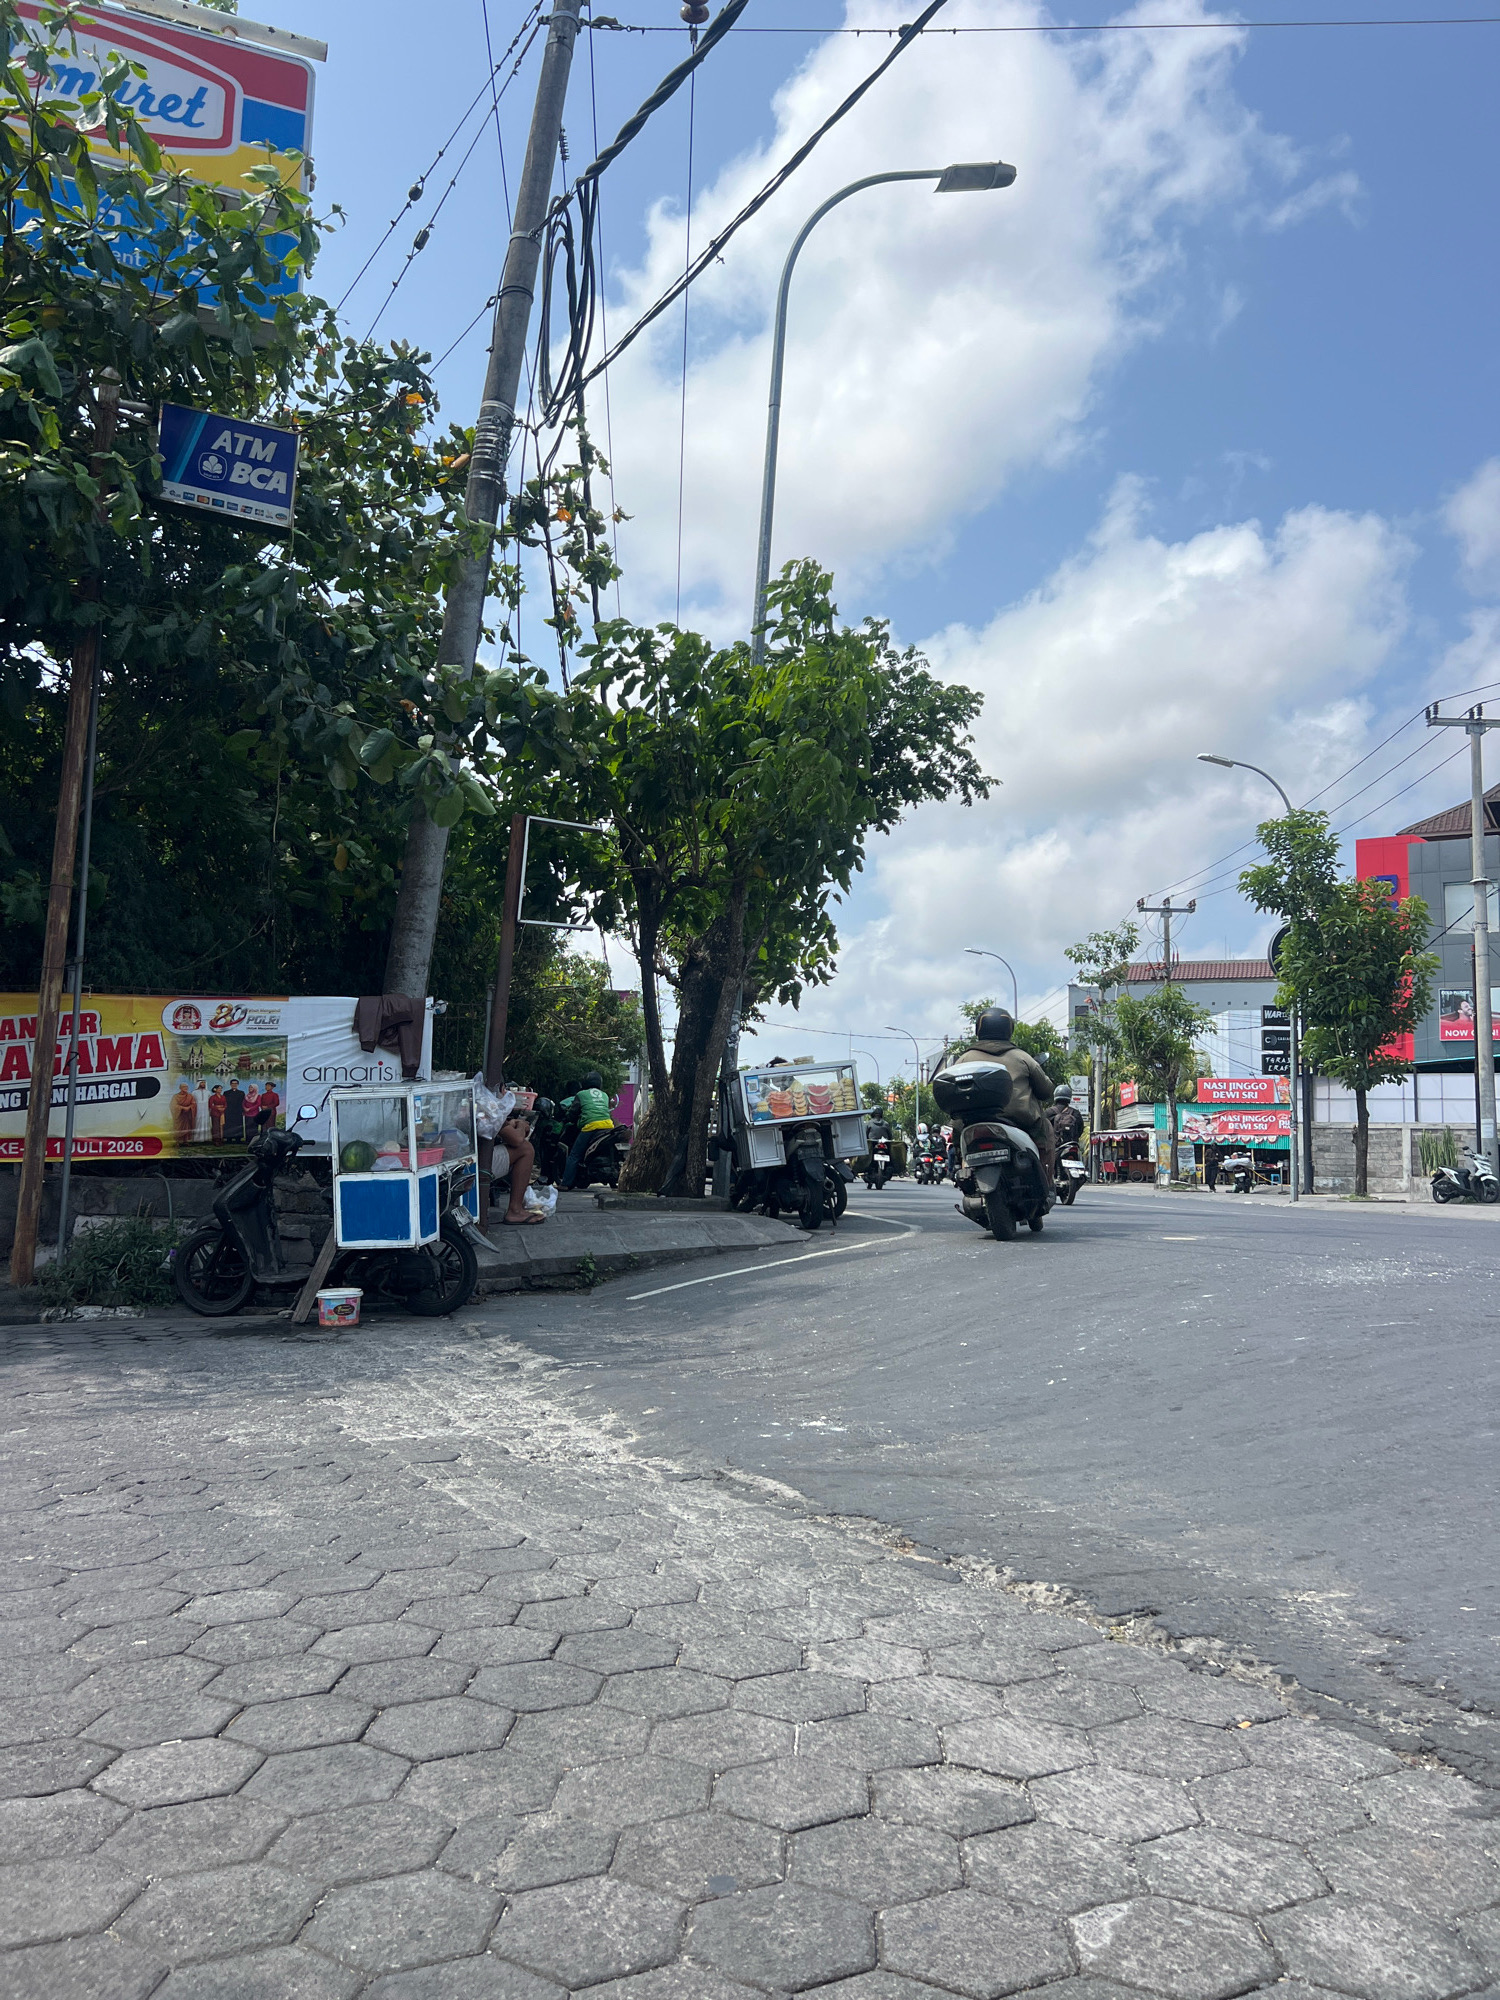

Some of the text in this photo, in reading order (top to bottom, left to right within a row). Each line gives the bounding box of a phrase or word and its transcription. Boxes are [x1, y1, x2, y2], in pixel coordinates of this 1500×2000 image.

[211, 430, 278, 463] ATM
[229, 461, 288, 494] BCA
[246, 1015, 280, 1025] POLRI
[302, 1061, 394, 1082] amaris
[1203, 1082, 1267, 1092] NASI JINGGO
[1213, 1091, 1258, 1099] DEWI SRI
[1221, 1114, 1276, 1123] NASI JINGGO
[54, 1141, 61, 1154] 1
[71, 1141, 102, 1154] JULI
[108, 1141, 144, 1153] 2026
